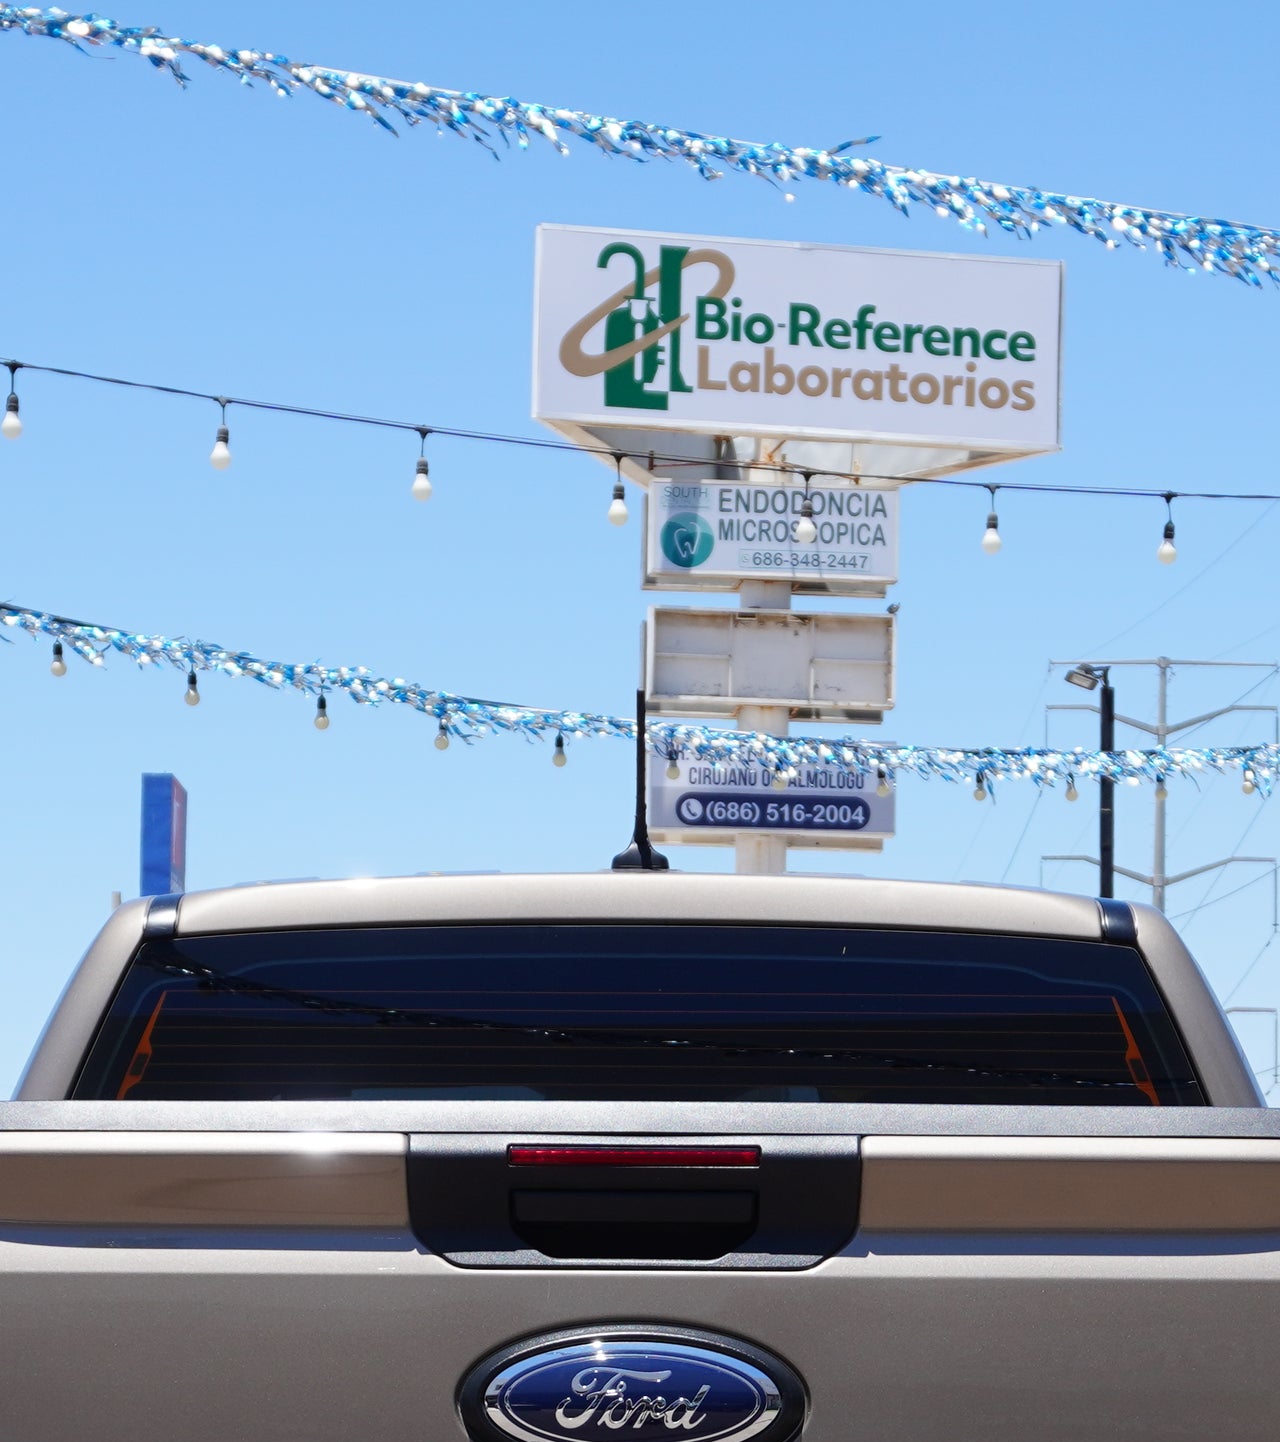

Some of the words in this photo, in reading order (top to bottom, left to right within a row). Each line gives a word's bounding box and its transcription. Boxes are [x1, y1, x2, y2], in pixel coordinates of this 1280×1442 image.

[695, 296, 1036, 362] Bio-Reference
[697, 345, 1036, 412] Laboratorios
[664, 486, 708, 498] SOUTH
[718, 488, 888, 518] ENDODONCIA
[752, 551, 869, 569] 686-348-2447
[705, 800, 760, 823] (686)
[766, 803, 865, 824] 516-2004
[555, 1366, 711, 1430] Ford
